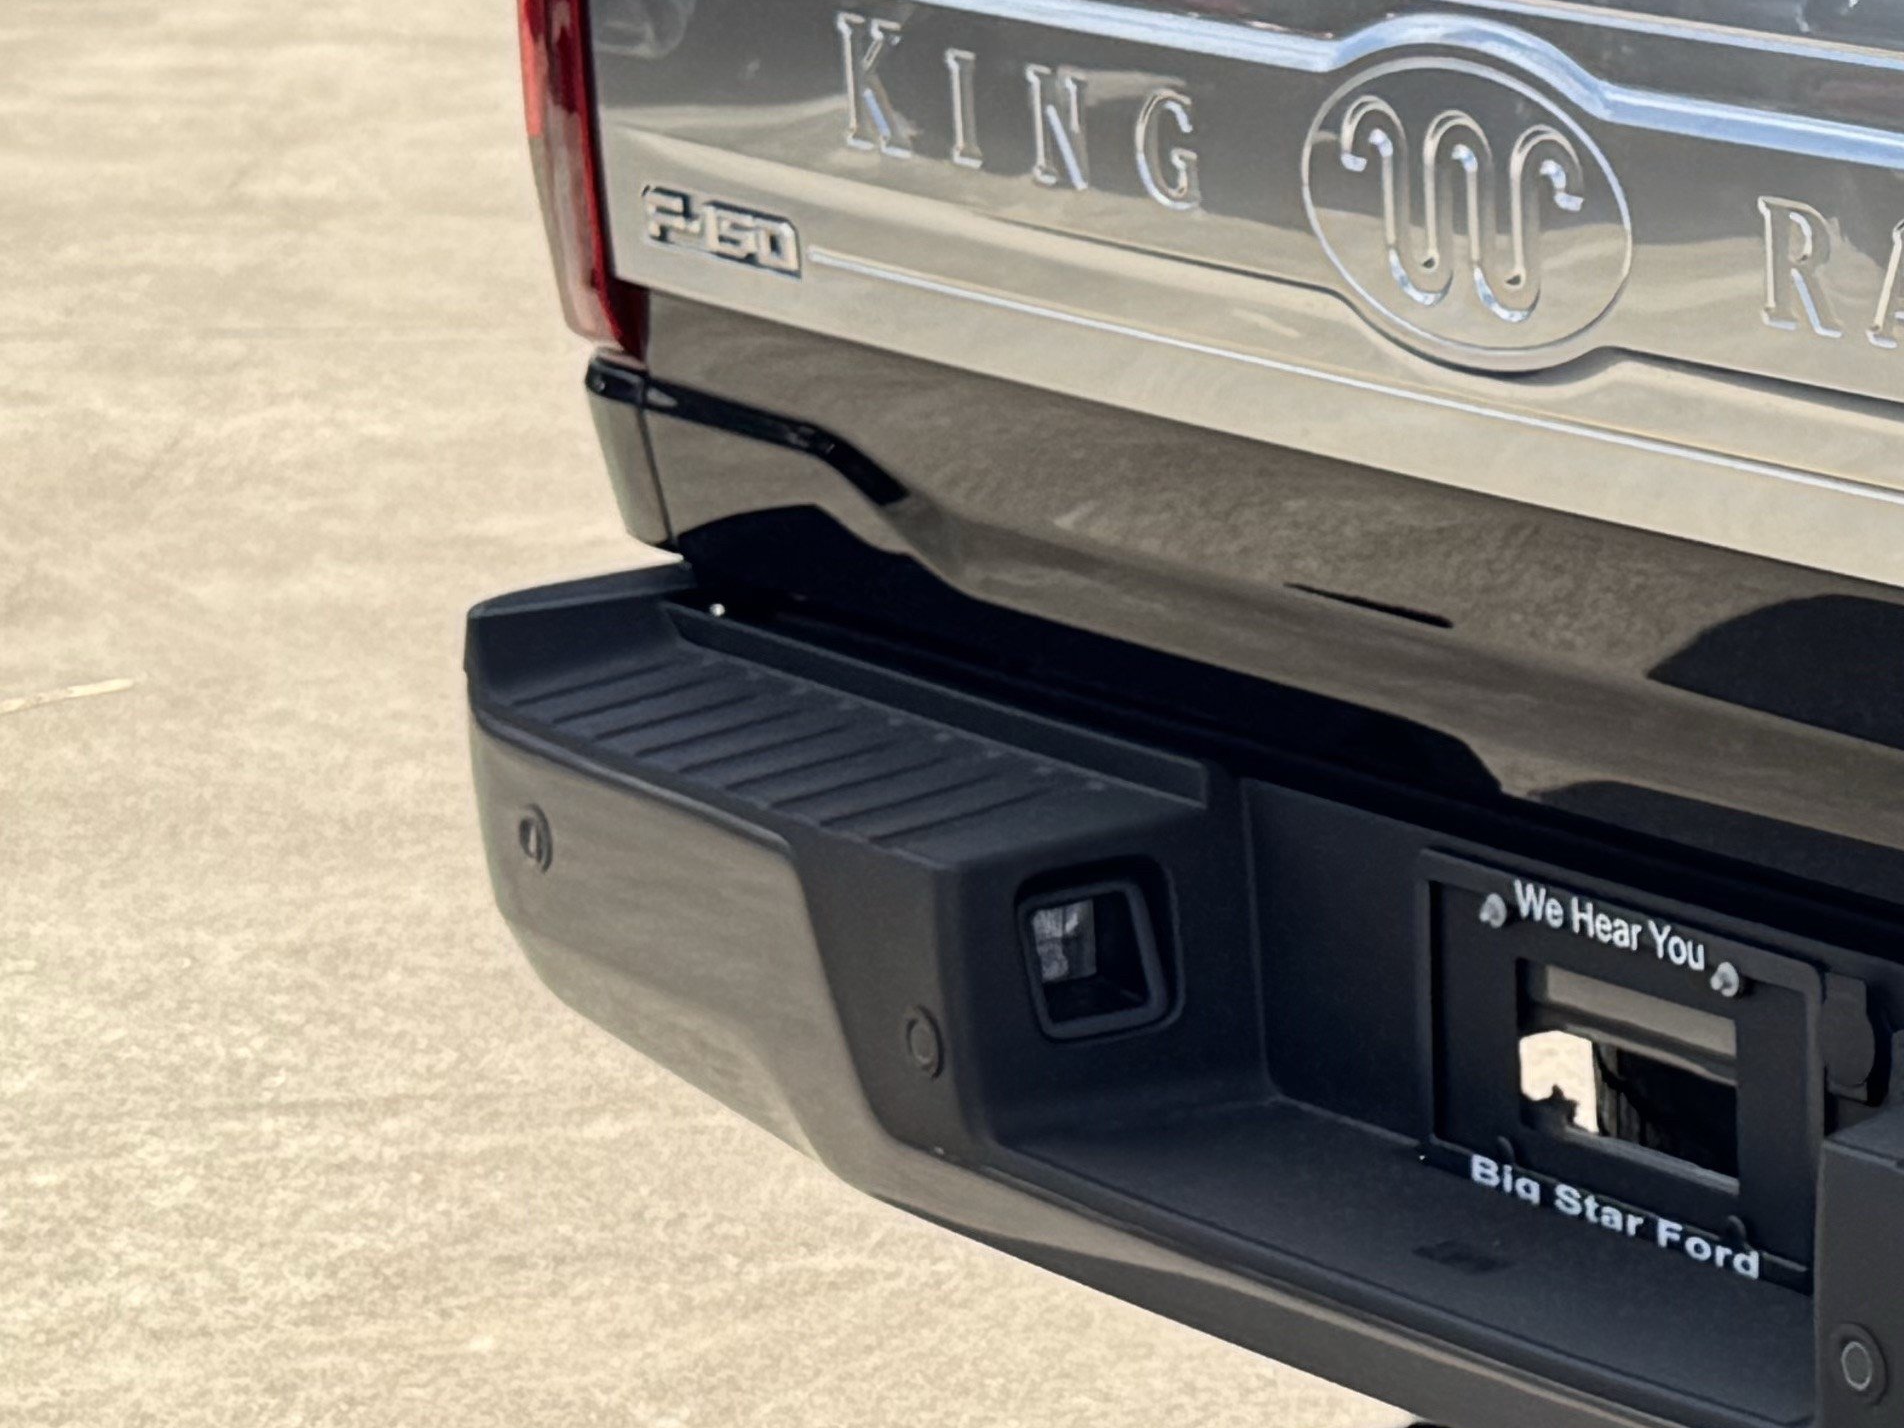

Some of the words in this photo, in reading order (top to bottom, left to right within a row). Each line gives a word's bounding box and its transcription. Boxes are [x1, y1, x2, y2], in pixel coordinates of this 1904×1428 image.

[835, 12, 1202, 211] KING
[642, 185, 802, 278] F-150
[1514, 879, 1564, 929] We
[1570, 895, 1642, 953] Hear
[1648, 920, 1705, 970] You
[1470, 1154, 1541, 1206] Big
[1555, 1182, 1643, 1237] Star
[1656, 1218, 1761, 1280] Ford
